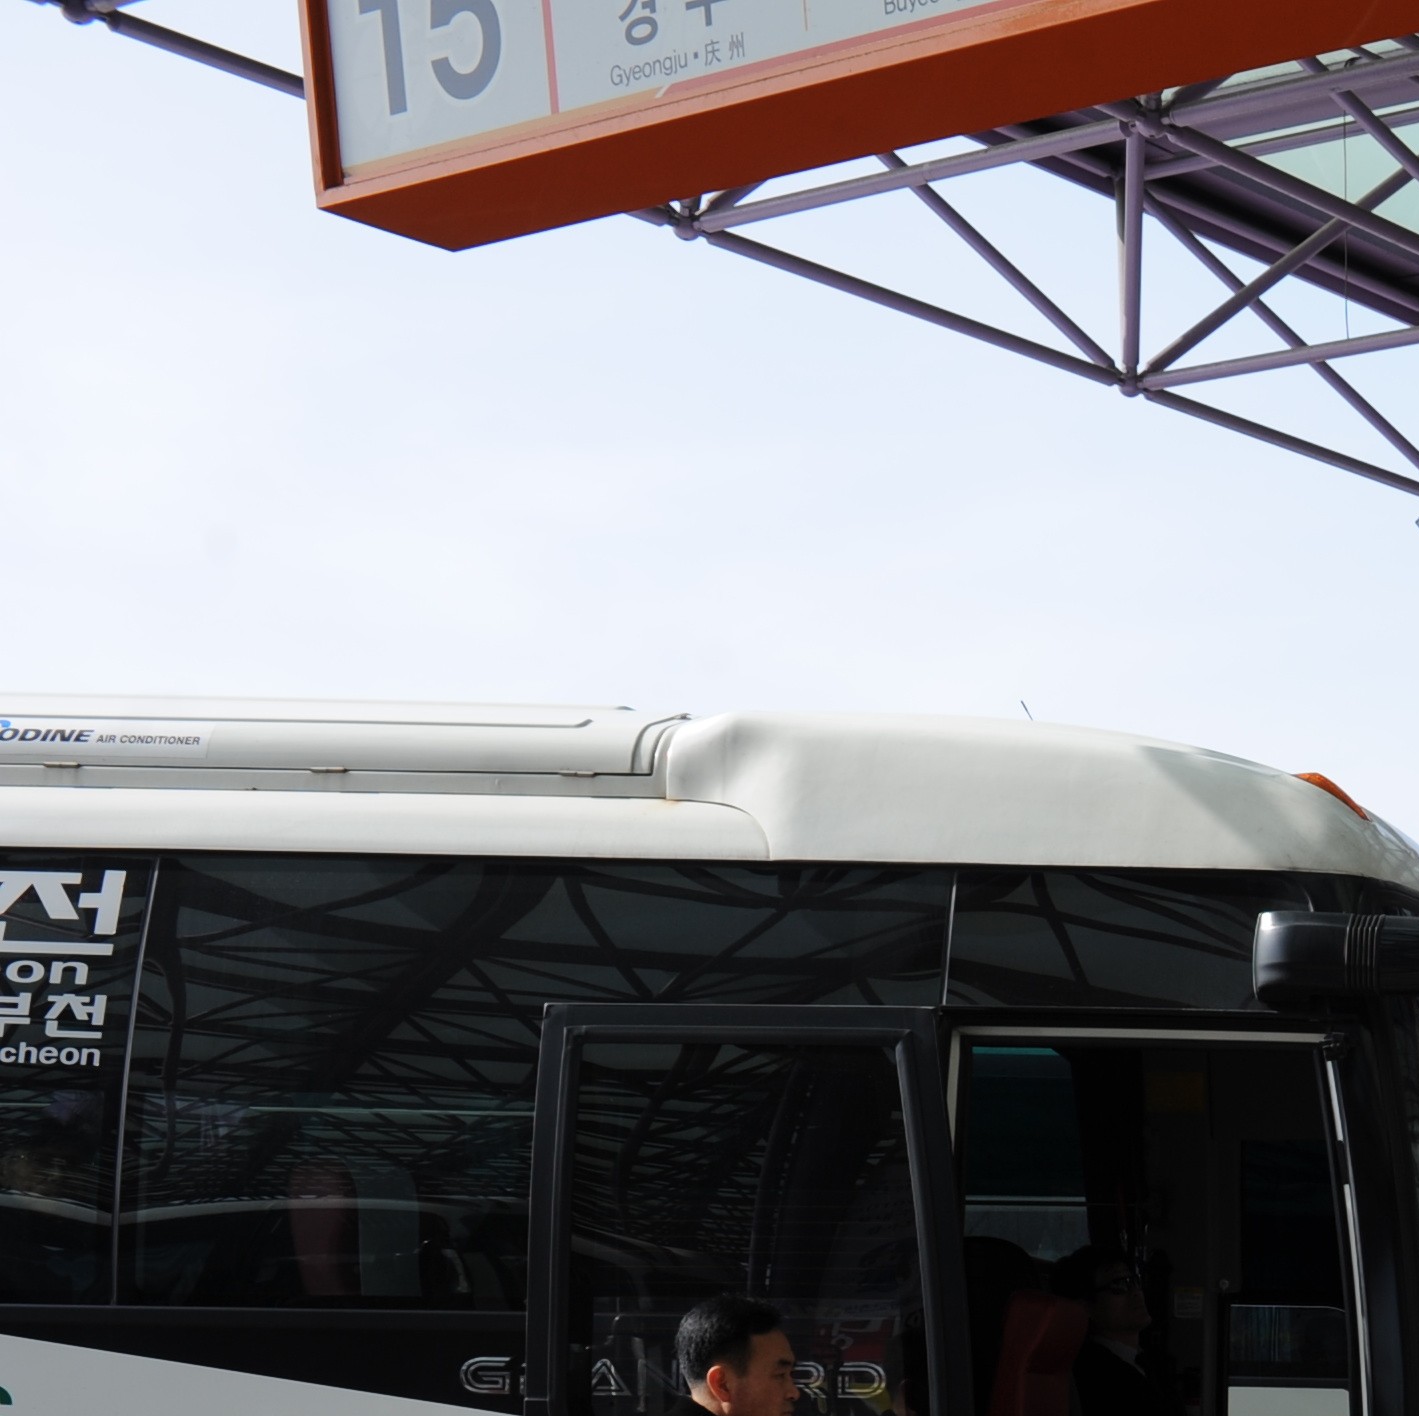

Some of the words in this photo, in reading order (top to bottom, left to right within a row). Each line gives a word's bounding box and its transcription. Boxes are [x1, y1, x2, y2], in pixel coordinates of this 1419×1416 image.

[356, 0, 503, 117] 15
[610, 50, 688, 86] Gyeongju
[0, 728, 95, 743] ODINE
[96, 734, 116, 744] AIR
[120, 734, 200, 746] CONDITIONER
[0, 870, 127, 956] 전
[0, 1042, 100, 1067] cheon
